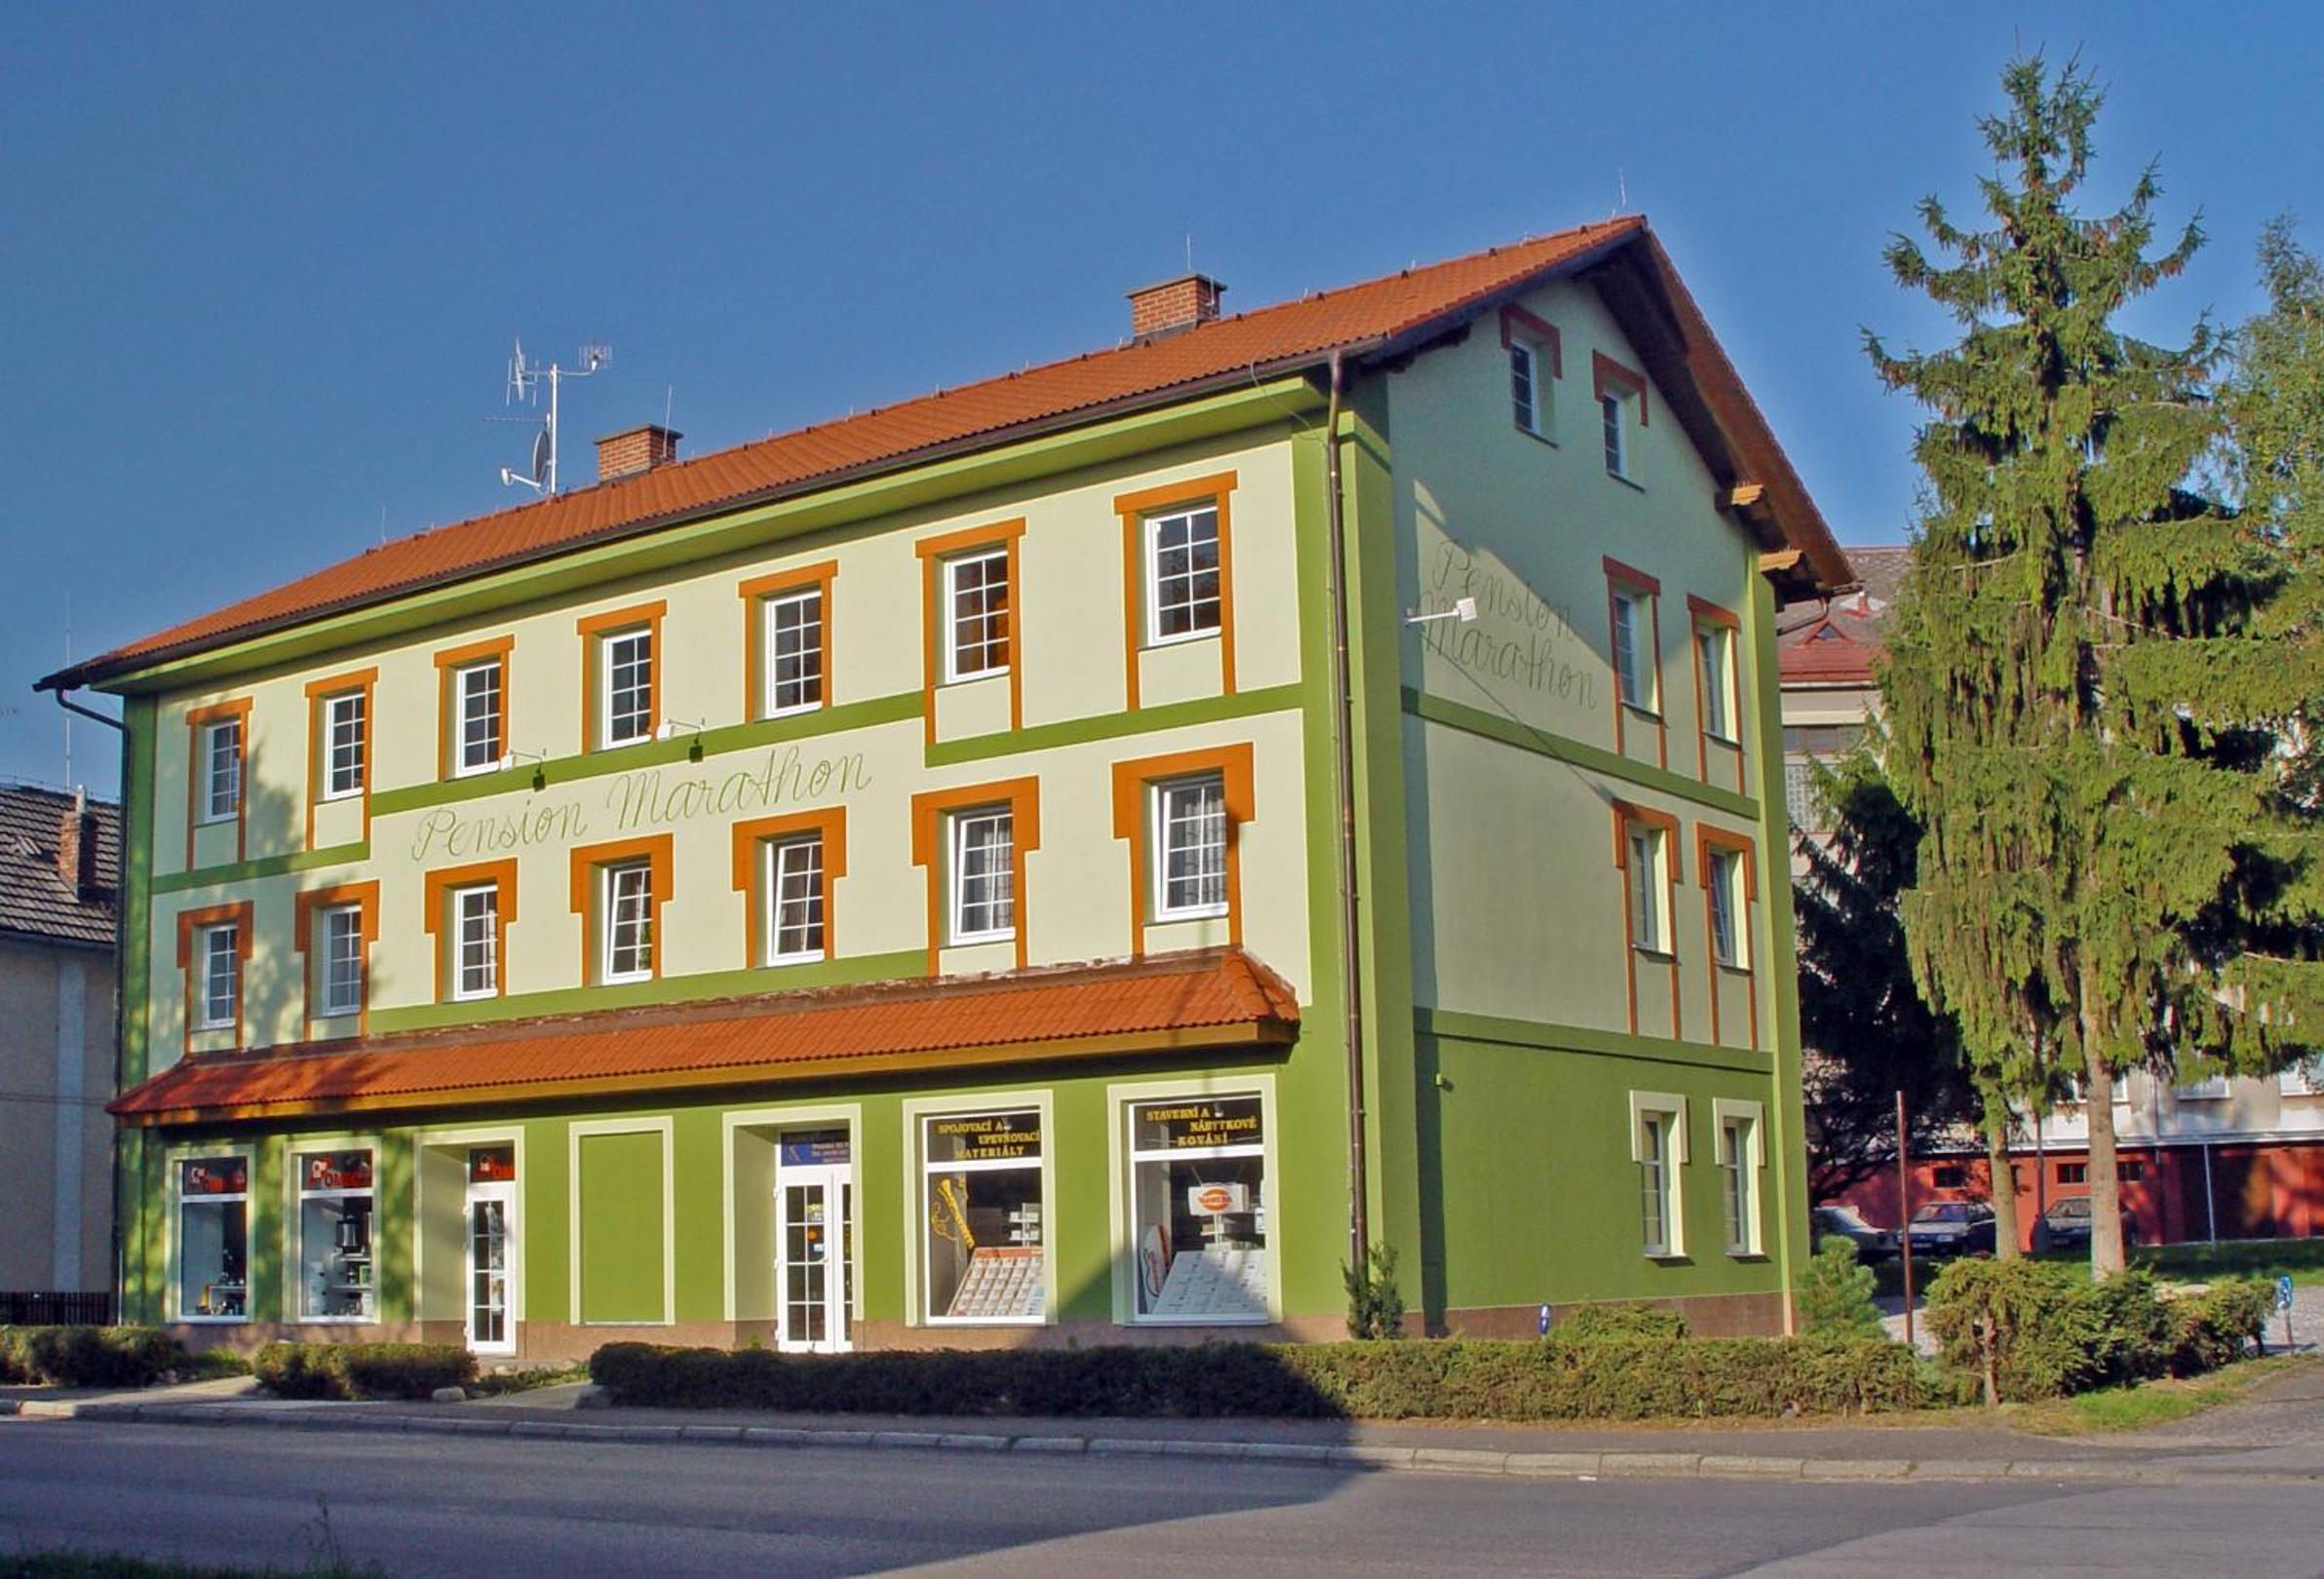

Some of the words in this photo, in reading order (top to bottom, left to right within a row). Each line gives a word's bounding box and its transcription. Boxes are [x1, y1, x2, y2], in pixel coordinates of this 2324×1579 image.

[1416, 589, 1598, 710] Marathon
[410, 799, 588, 862] Pension
[605, 744, 872, 830] Marathon
[1200, 1107, 1210, 1118] A
[994, 1120, 1003, 1132] A
[1177, 1132, 1227, 1146] KOVÁNÍ
